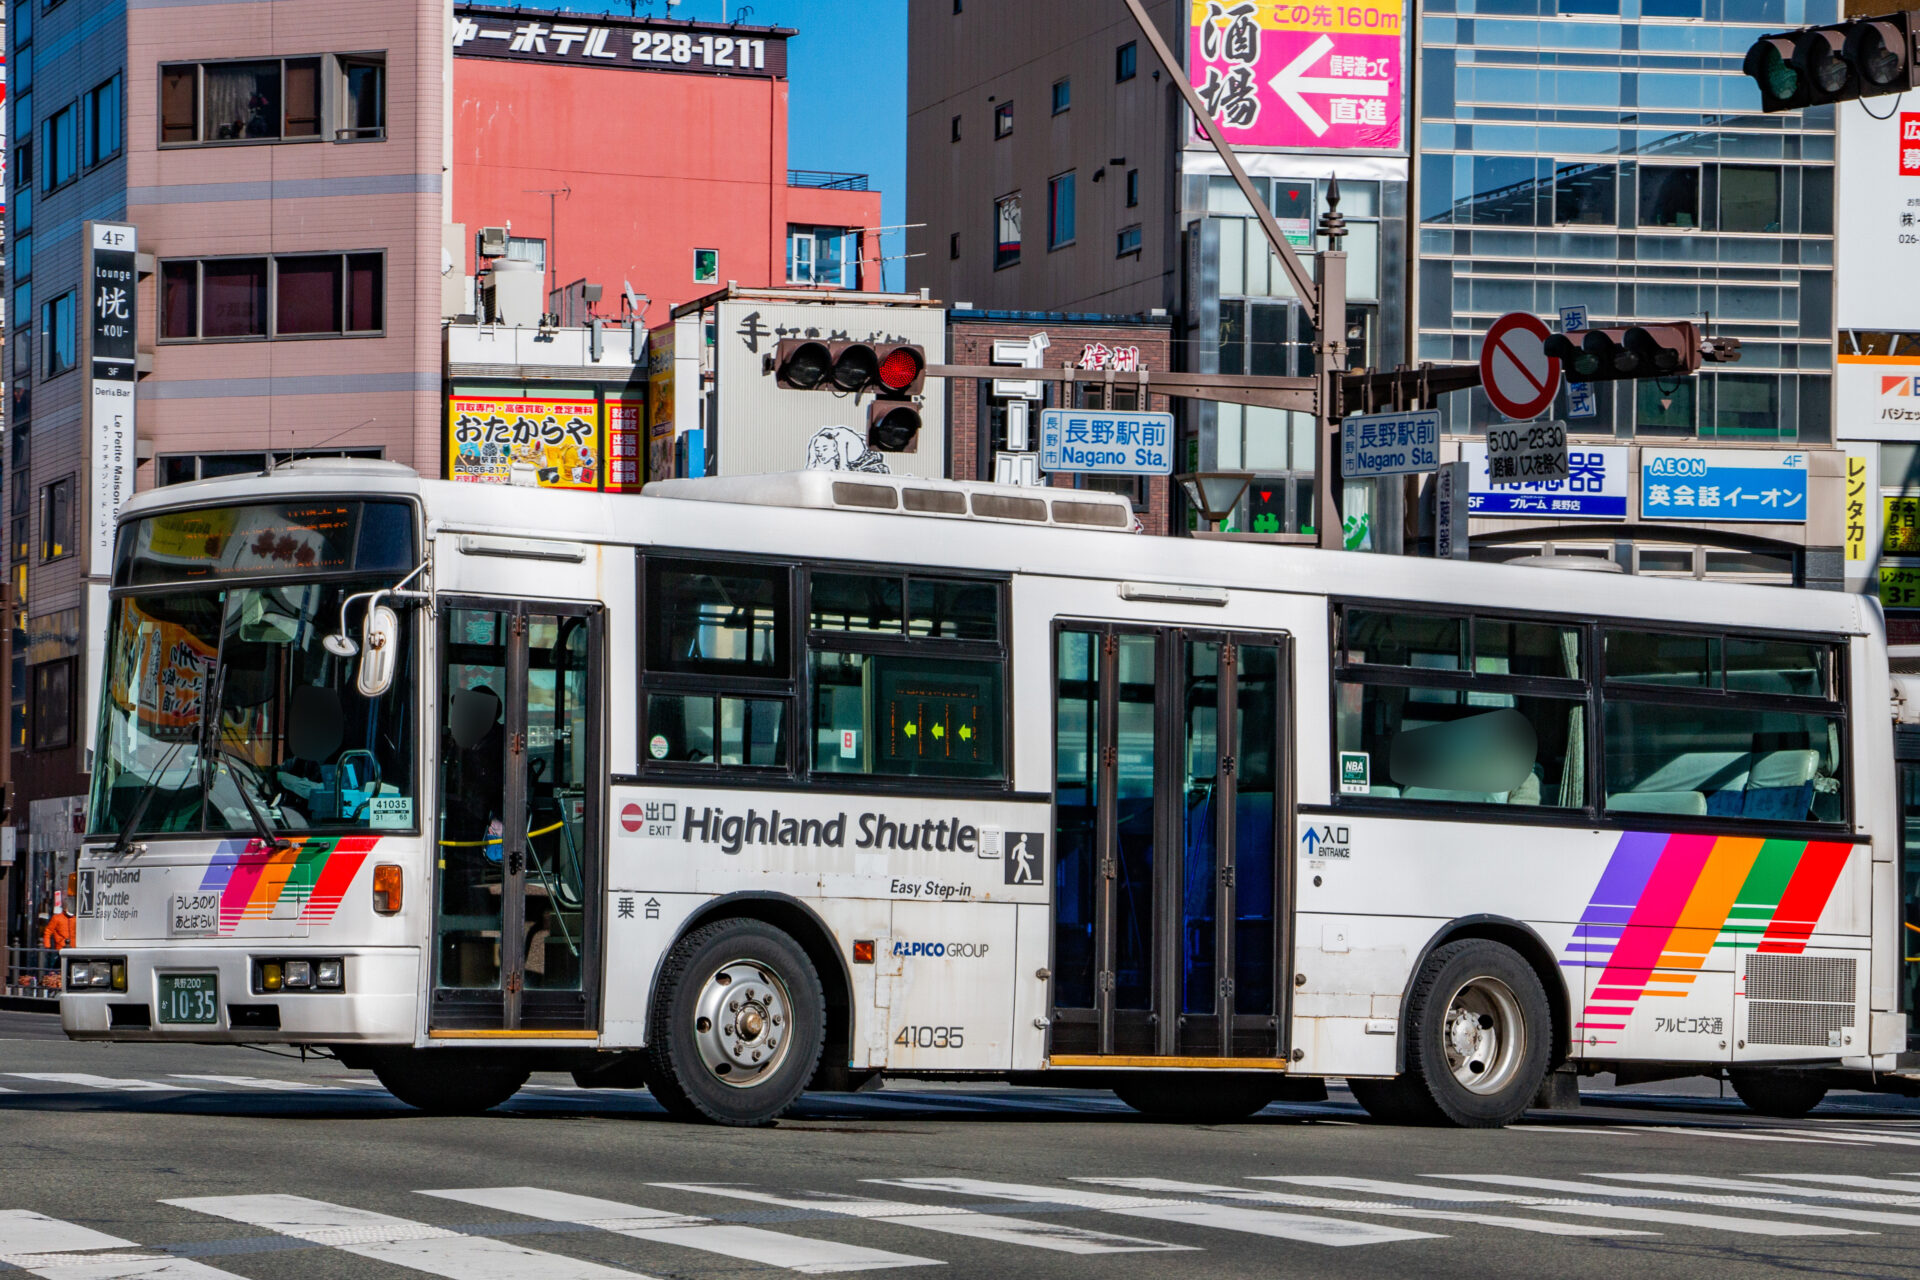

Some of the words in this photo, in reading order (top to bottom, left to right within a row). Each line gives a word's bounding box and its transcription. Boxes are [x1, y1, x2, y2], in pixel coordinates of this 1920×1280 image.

[1273, 4, 1332, 27] この先
[1337, 6, 1398, 28] 160m
[632, 31, 765, 69] 228-1211
[1196, 2, 1260, 127] 酒場
[1329, 54, 1389, 78] 信号渡って
[1329, 97, 1386, 126] 直進
[102, 230, 125, 246] 4F
[96, 266, 131, 281] Lounge
[1080, 343, 1140, 372] 信州
[107, 367, 120, 376] 3F
[455, 413, 592, 446] おたからや
[1065, 418, 1167, 447] 長野駅前
[1359, 419, 1435, 448] 長野駅前
[1045, 417, 1059, 464] 長野市
[1345, 424, 1355, 471] 長野市
[1062, 446, 1126, 467] Nagano
[1135, 449, 1167, 467] Sta.
[1357, 451, 1406, 471] Nagano
[1411, 447, 1437, 465] Sta.
[1782, 454, 1803, 467] 4F
[1651, 458, 1705, 475] AEON
[112, 466, 123, 504] Maison
[1467, 496, 1485, 508] 5F
[1551, 500, 1581, 511] 長野店
[1648, 484, 1803, 508] 英会話イーオン
[1847, 457, 1865, 559] レンタカー
[1887, 586, 1916, 603] 3F
[1345, 761, 1364, 772] NBA
[376, 800, 407, 809] 41035
[645, 802, 676, 821] 出口
[649, 825, 672, 836] EXIT
[682, 806, 847, 855] Highland
[855, 812, 978, 853] Shuttle
[1322, 826, 1349, 844] 入口
[1318, 846, 1350, 858] ENTRANCE
[97, 869, 140, 888] Highland
[96, 891, 130, 906] Shuttle
[890, 879, 922, 898] Easy
[924, 880, 971, 899] Step-in
[176, 895, 216, 910] うしろのり
[617, 896, 661, 920] 乗合
[95, 908, 111, 920] Easy
[112, 907, 138, 920] Step-in
[175, 914, 215, 929] あとばらい
[893, 941, 945, 957] ALPICO
[946, 943, 989, 958] GROUP
[171, 990, 215, 1019] 10-35
[1654, 1016, 1723, 1035] アルピコ交通
[894, 1025, 964, 1049] 41035
